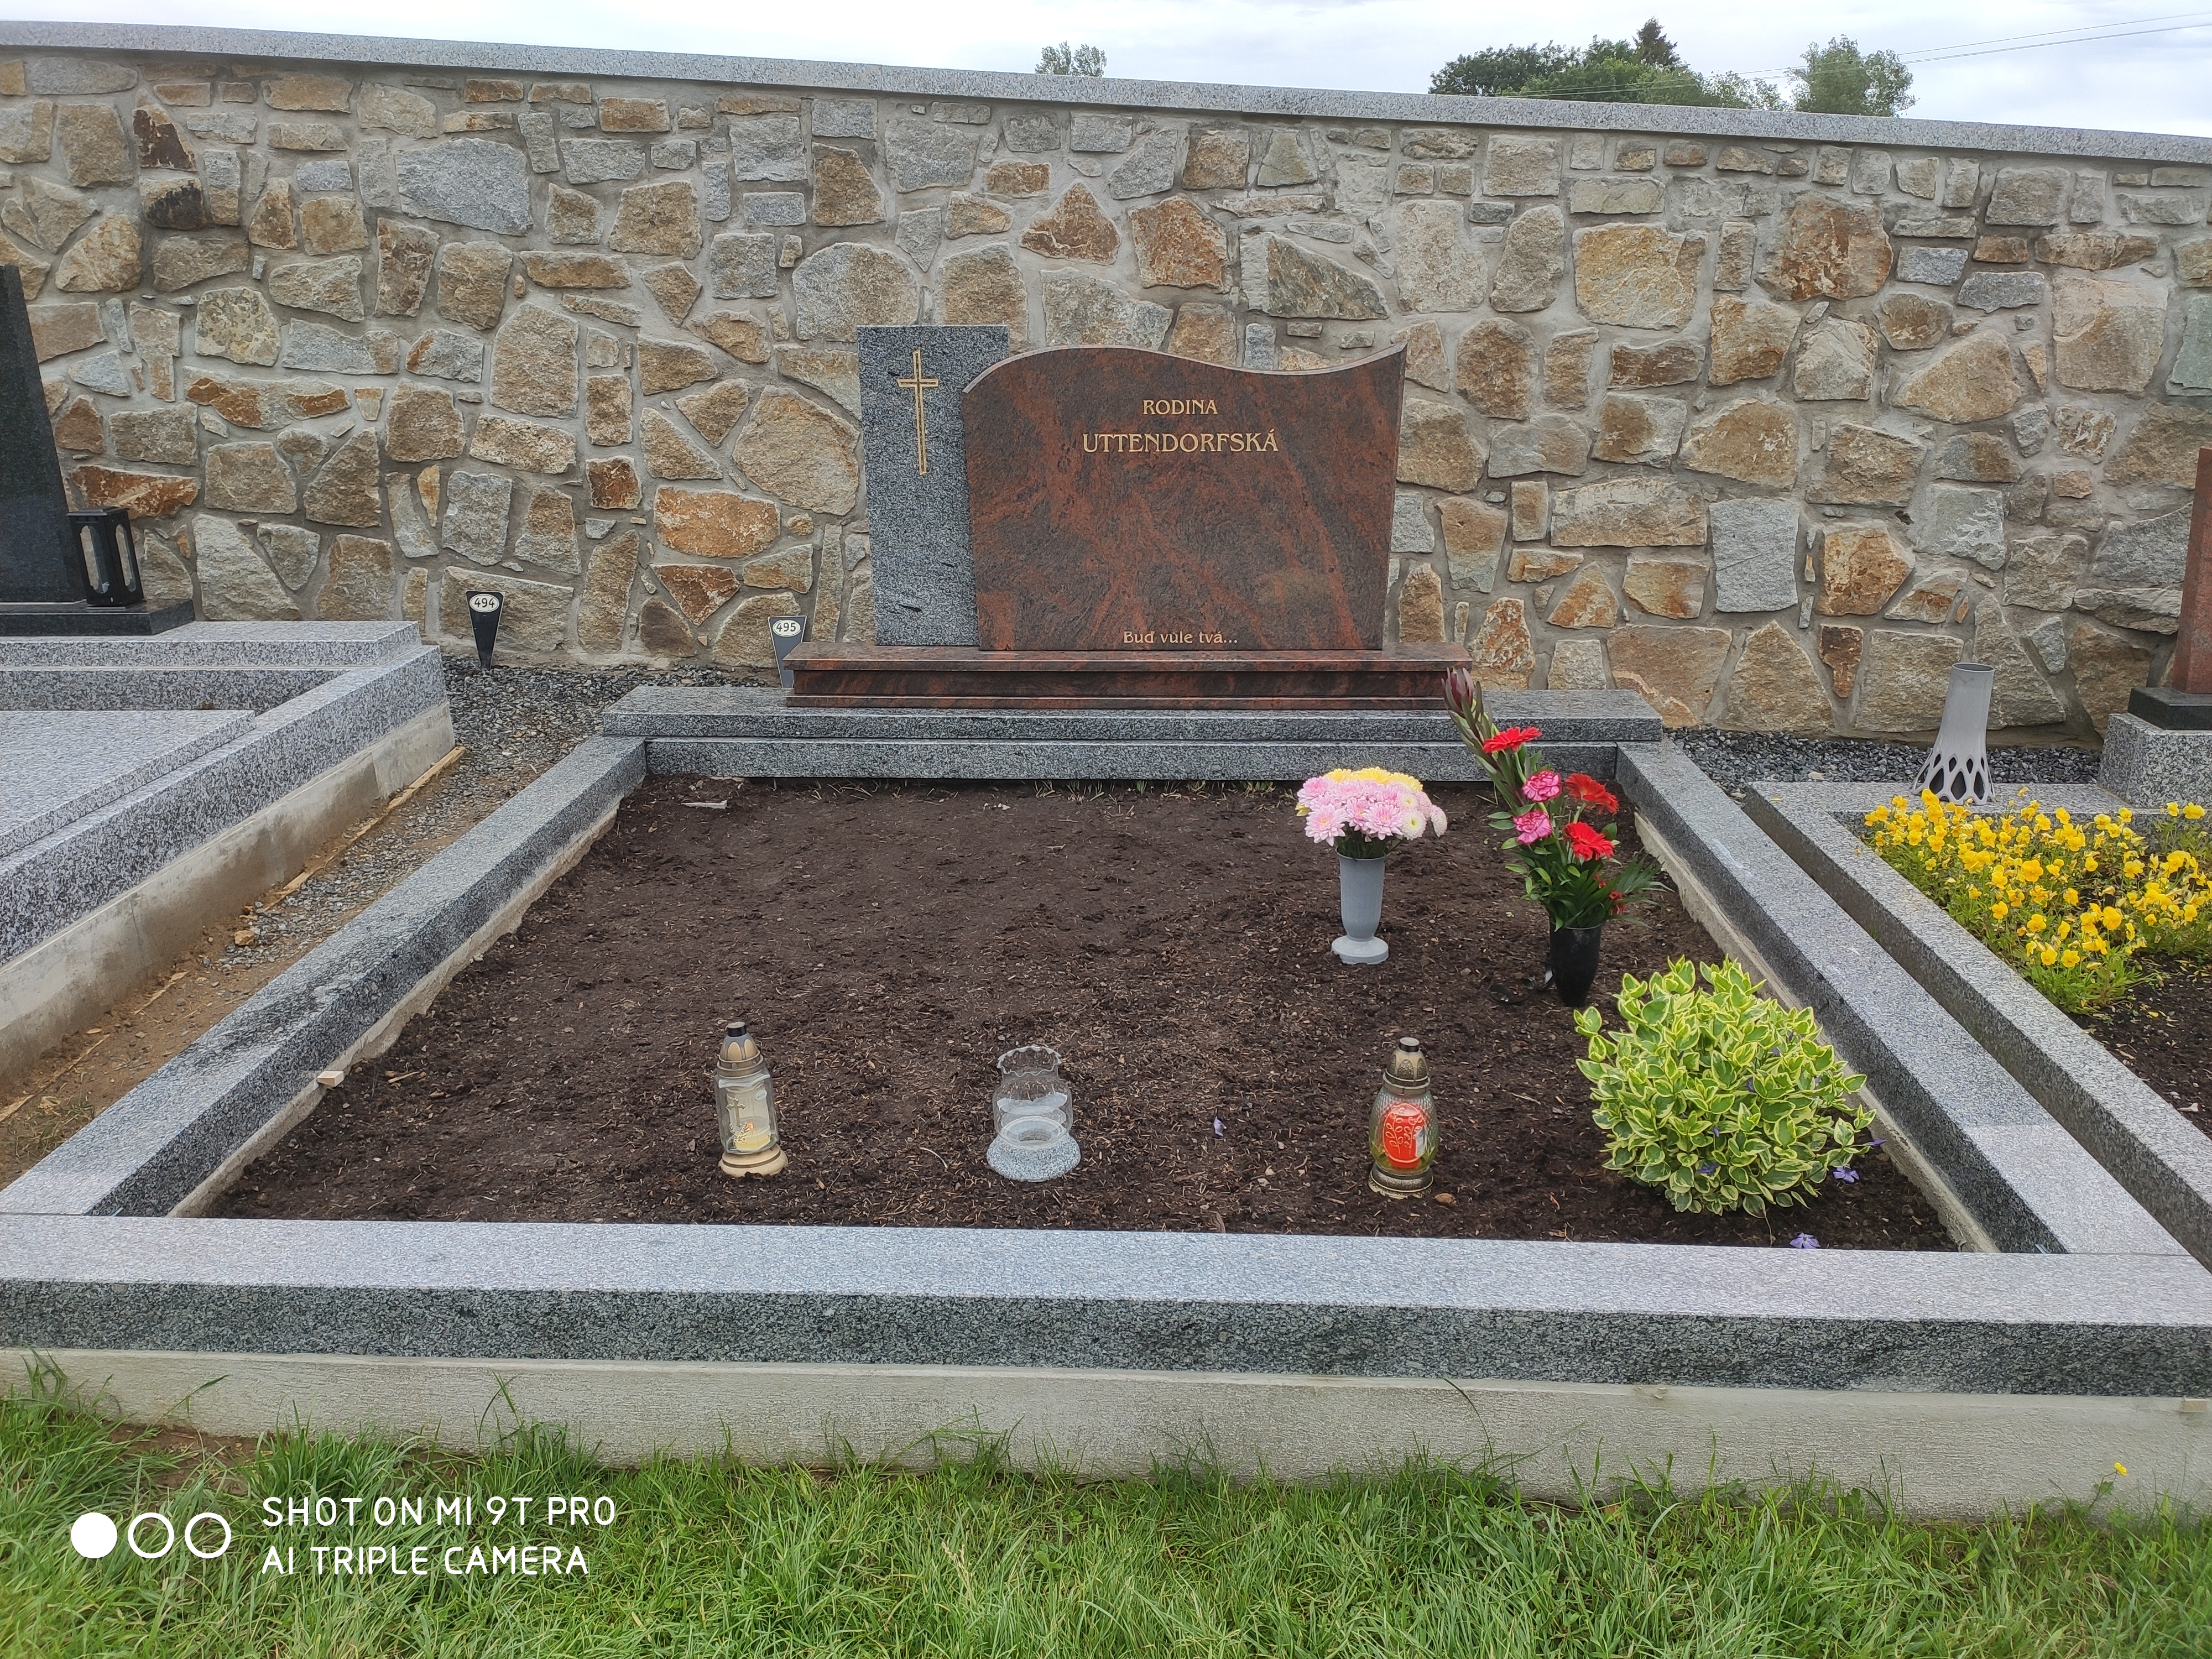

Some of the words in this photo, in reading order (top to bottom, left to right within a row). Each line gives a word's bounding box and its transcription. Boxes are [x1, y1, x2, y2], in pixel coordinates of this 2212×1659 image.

[1142, 399, 1218, 415] RODINA
[1082, 428, 1279, 453] UTTENDORFSKÁ
[474, 597, 495, 608] 494
[776, 622, 796, 633] 495
[1199, 631, 1238, 644] tvá...
